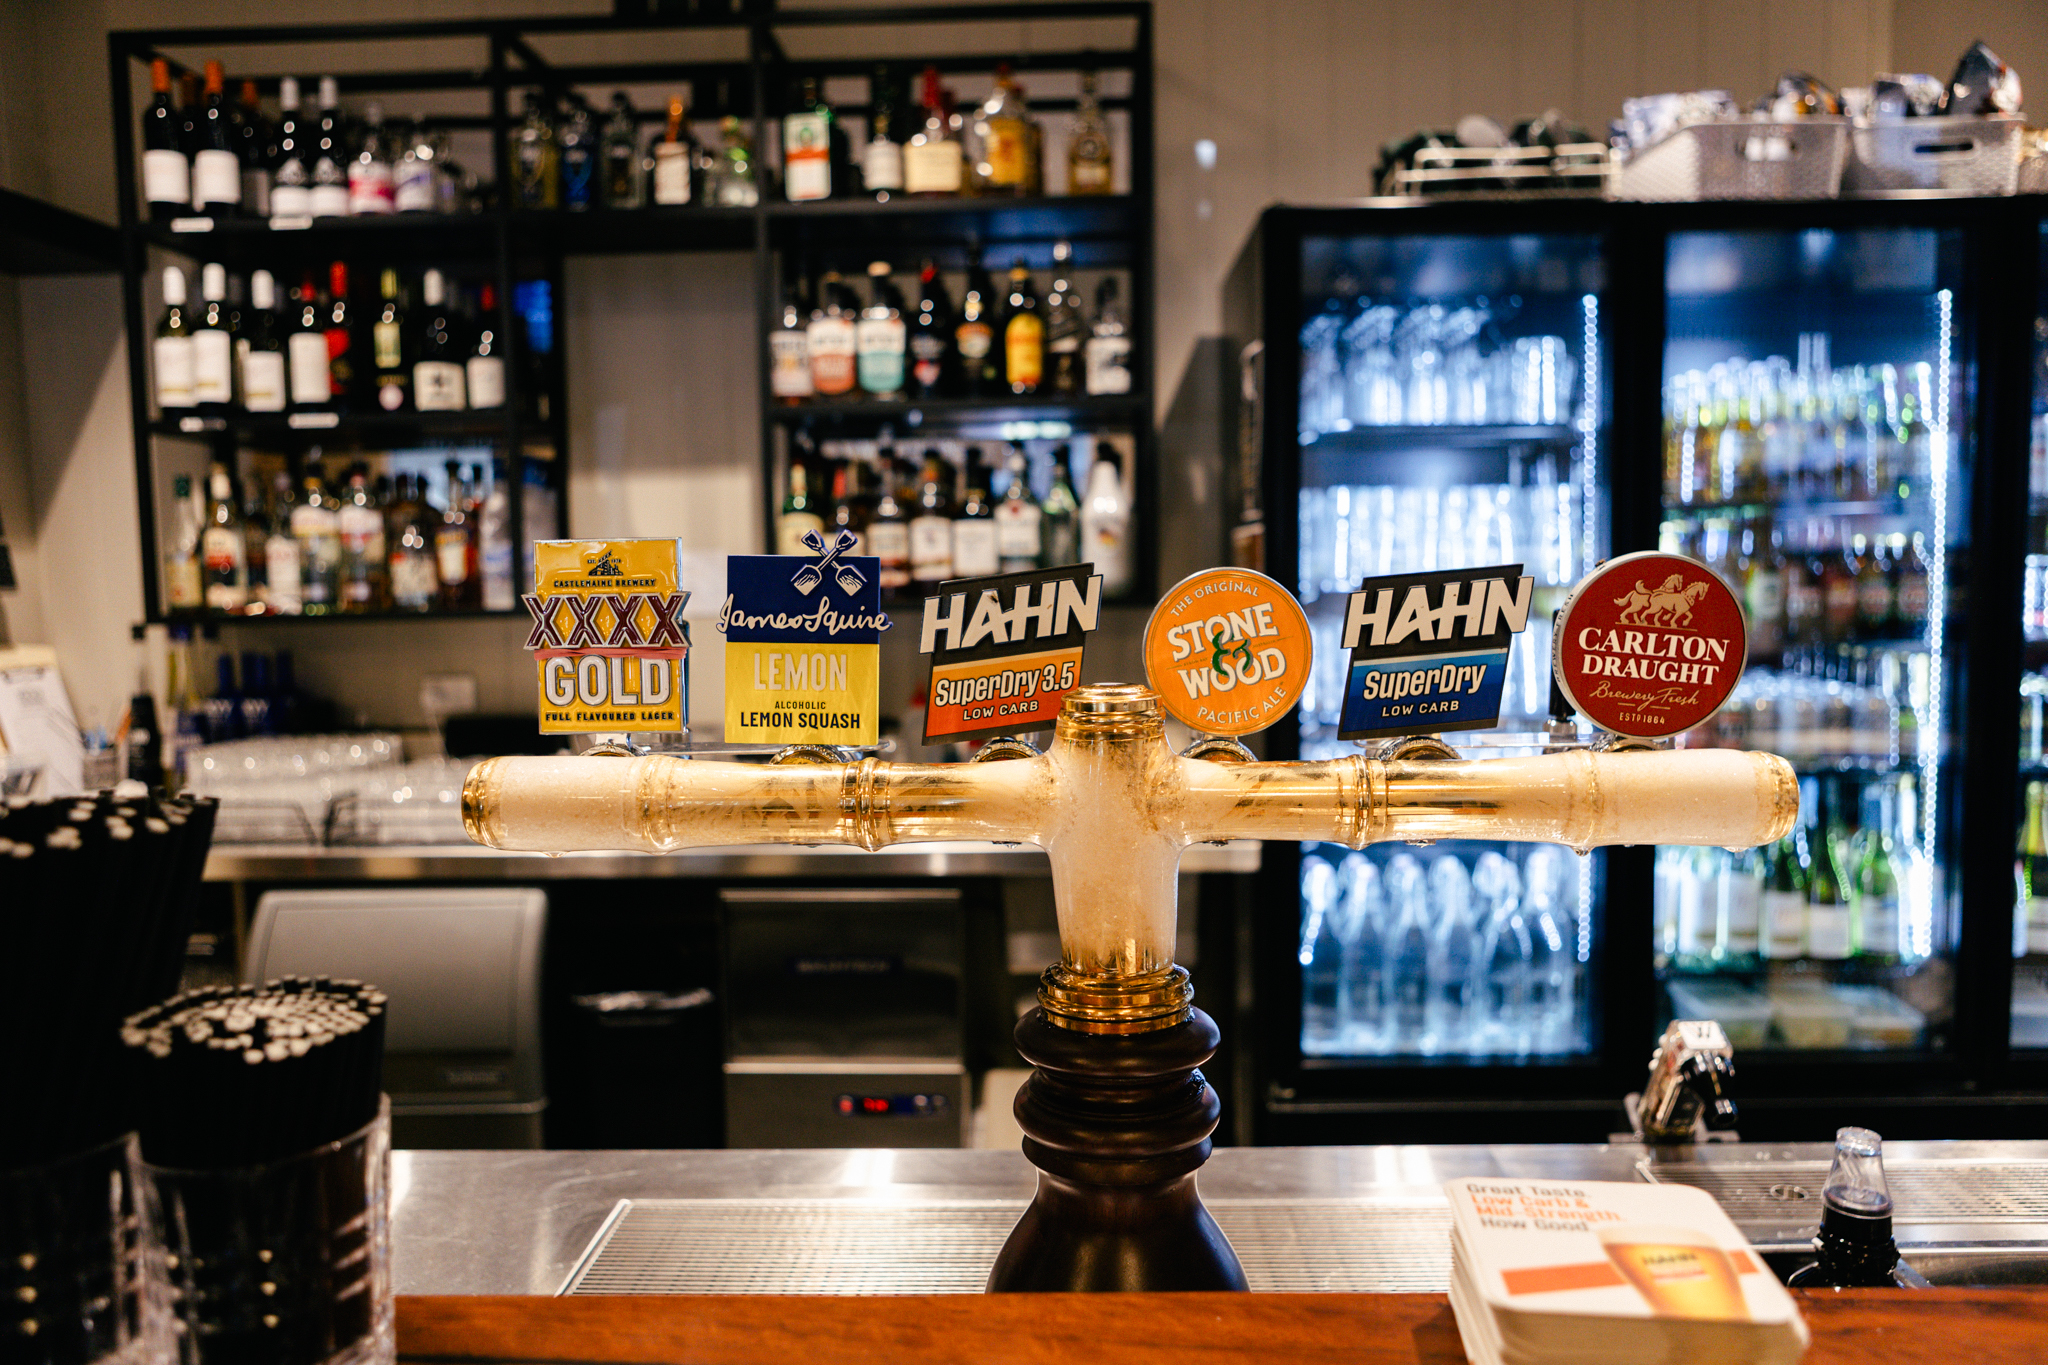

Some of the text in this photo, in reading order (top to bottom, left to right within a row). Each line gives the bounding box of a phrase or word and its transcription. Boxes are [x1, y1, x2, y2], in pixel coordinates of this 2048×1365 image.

[554, 579, 655, 588] CASTLEMAINE BREWERY
[1170, 581, 1259, 617] THE ORIGINAL
[521, 592, 691, 649] XXXX
[716, 593, 893, 635] James Squire
[919, 574, 1104, 654] HAHN
[1341, 576, 1535, 649] HAHN
[1167, 602, 1280, 662] STONE
[1578, 627, 1730, 662] CARLTON
[1212, 630, 1252, 676] &
[1581, 654, 1719, 685] DRAUGHT
[545, 655, 671, 707] GOLD
[754, 653, 847, 691] LEMON
[935, 661, 1076, 707] SuperDry 3.5
[1177, 647, 1287, 700] WOOD
[1363, 664, 1487, 700] SuperDry
[775, 701, 826, 709] ALCOHOLIC
[963, 701, 1039, 721] LOW CARB
[1197, 686, 1287, 724] PACIFIC ALE
[1382, 700, 1459, 717] LOW CARB
[1589, 680, 1699, 712] Brewery Fresh
[546, 712, 674, 721] FULL FLAVOURED LAGER
[740, 712, 860, 729] LEMON SQUASH
[1643, 714, 1665, 725] 1864
[1467, 1184, 1522, 1195] Great
[1471, 1194, 1590, 1208] Low Carb &
[1480, 1218, 1526, 1228] How
